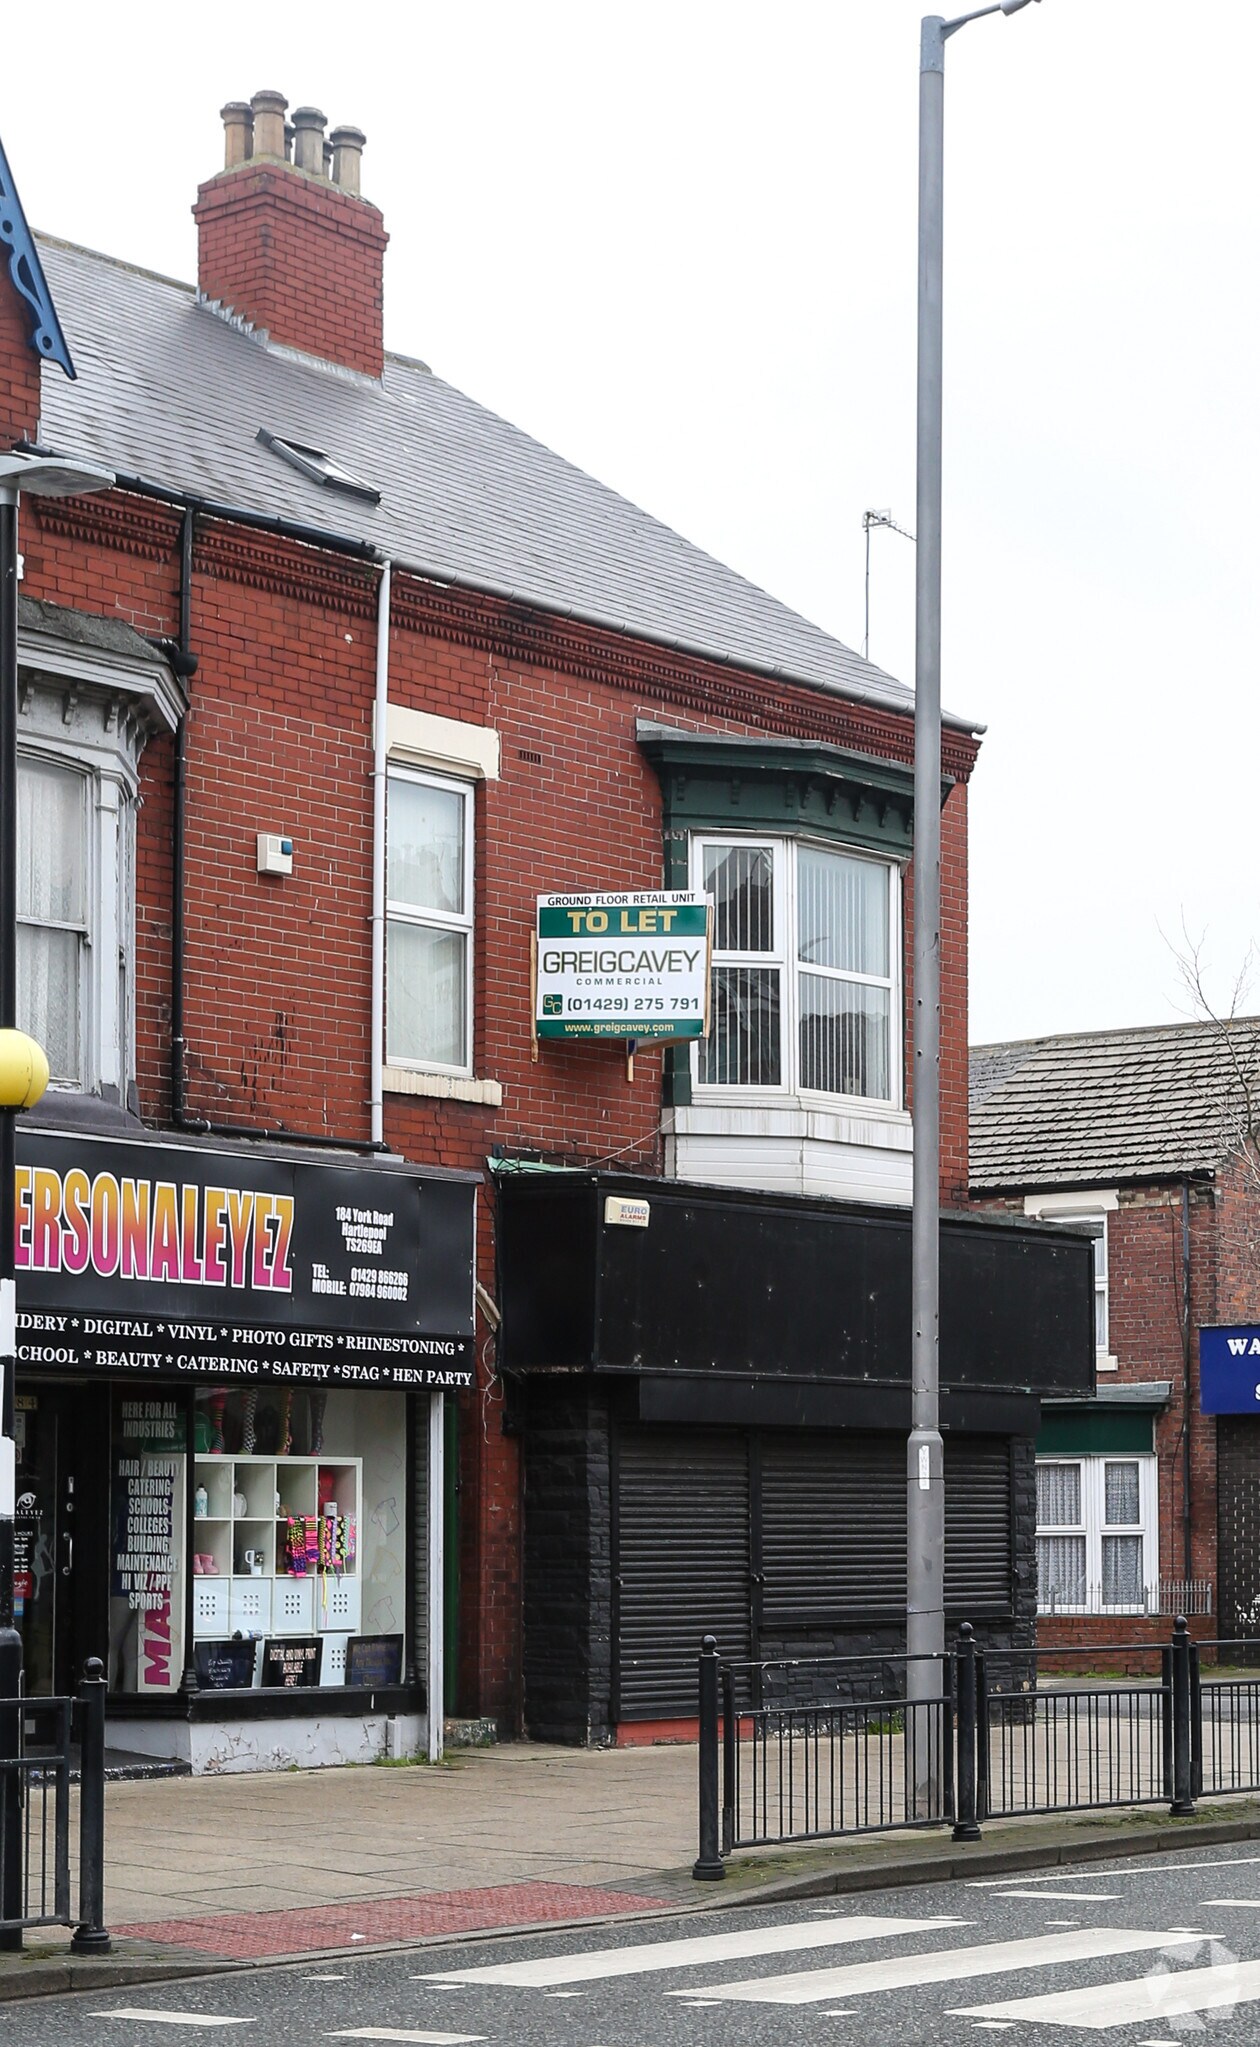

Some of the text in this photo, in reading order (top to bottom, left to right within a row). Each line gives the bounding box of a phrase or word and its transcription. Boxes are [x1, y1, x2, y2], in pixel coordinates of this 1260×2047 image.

[547, 893, 696, 906] GROUND FLOOR RETAIL UNIT
[567, 910, 678, 933] TO LET
[542, 949, 701, 974] GREIGCAVEY
[576, 977, 663, 986] COMMERCIAL
[567, 997, 699, 1012] (01429) 275 791
[564, 1022, 675, 1034] www.greigcavey.com
[335, 1206, 394, 1227] 184 York Road
[620, 1213, 646, 1221] ALARMS
[621, 1205, 648, 1215] EURO
[341, 1221, 387, 1240] Hartlepool
[312, 1263, 330, 1279] TEL:
[351, 1267, 377, 1283] 01429
[312, 1279, 408, 1301] MOBILE: 07984 960002
[83, 1318, 153, 1337] DIGITAL
[168, 1324, 217, 1341] VINYL
[232, 1328, 286, 1346] PHOTO
[289, 1332, 334, 1349] GIFTS
[346, 1336, 455, 1356] RHINESTONING
[96, 1350, 162, 1368] BEAUTY
[177, 1355, 259, 1374] CATERING
[272, 1361, 331, 1378] SAFETY
[341, 1365, 380, 1381] STAG
[392, 1367, 423, 1383] HEN
[426, 1369, 473, 1386] PARTY
[121, 1401, 177, 1419] HERE FOR ALL
[123, 1420, 175, 1438] INDUSTRIES
[119, 1459, 140, 1476] HAIR
[147, 1459, 180, 1477] BEAUTY
[128, 1478, 171, 1496] CATERING
[128, 1497, 169, 1515] SCHOOLS
[127, 1516, 169, 1534] COLLEGES
[127, 1535, 169, 1553] BUILDING
[117, 1553, 178, 1572] MAINTENANCE
[121, 1573, 131, 1590] HI
[134, 1573, 148, 1590] VIZ
[155, 1573, 171, 1591] PPE
[128, 1592, 164, 1610] SPORTS
